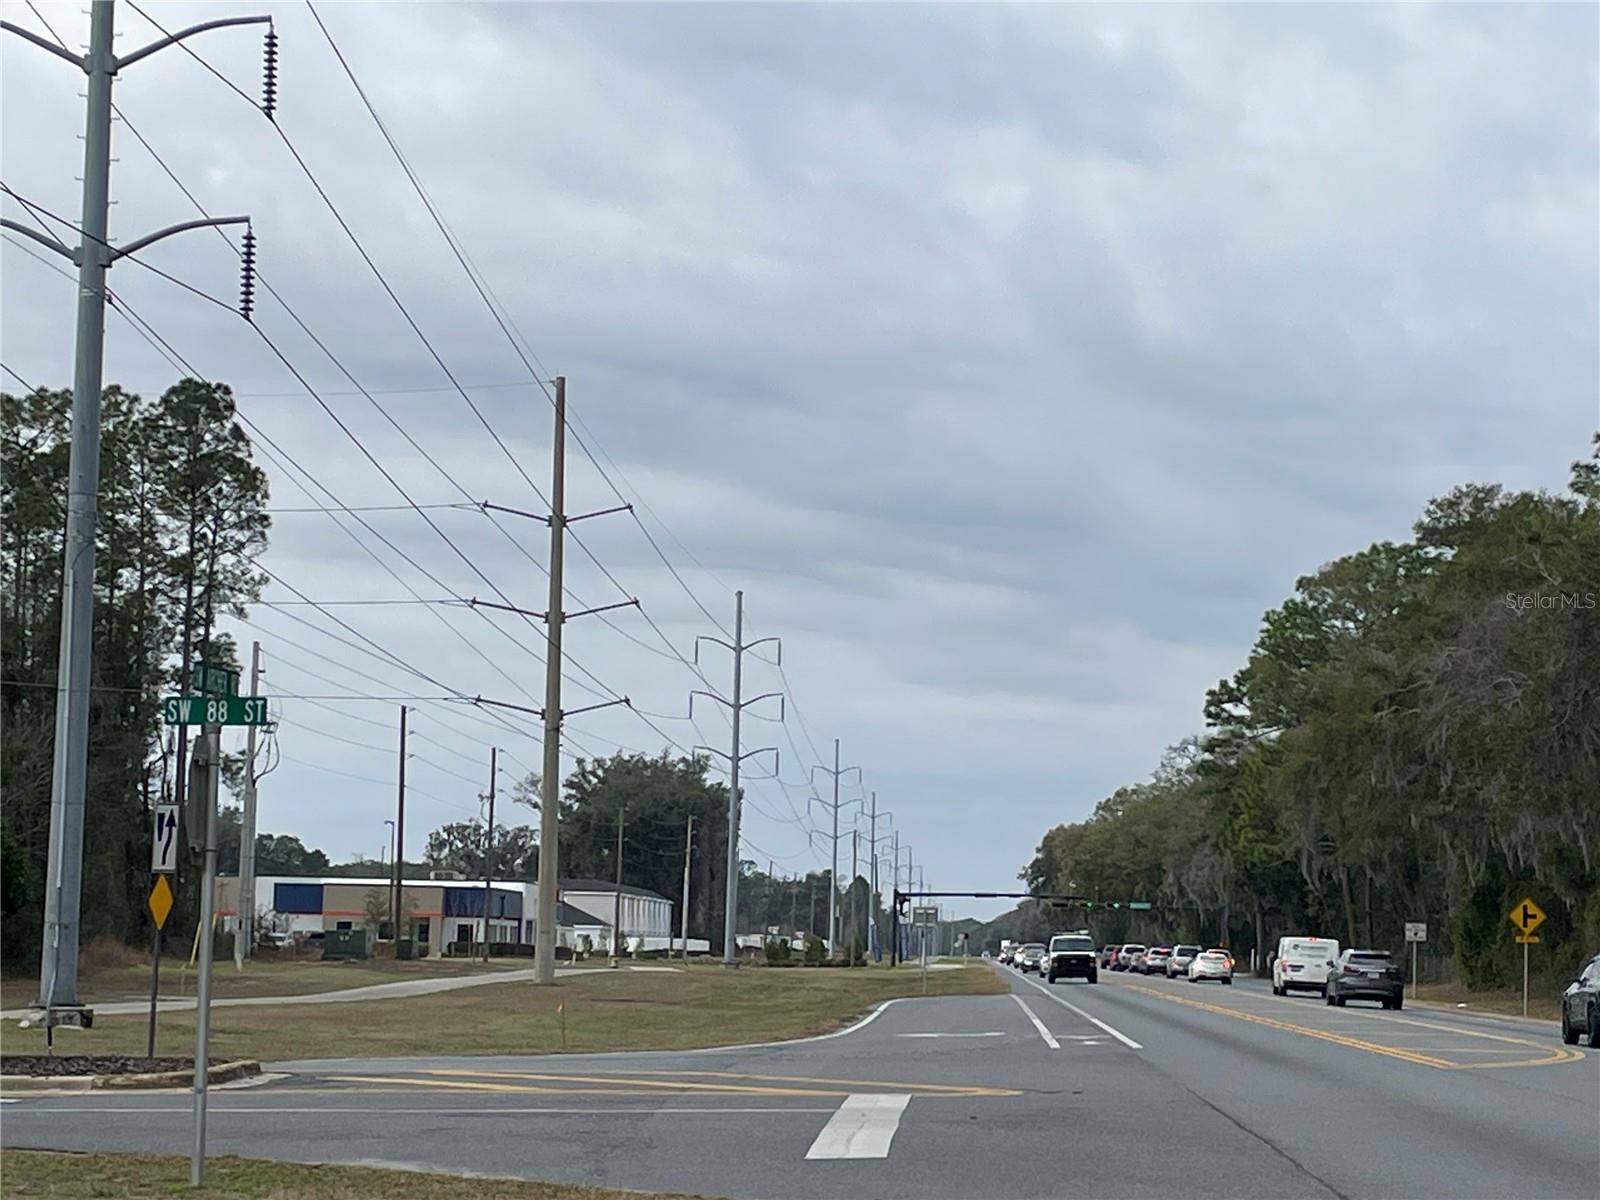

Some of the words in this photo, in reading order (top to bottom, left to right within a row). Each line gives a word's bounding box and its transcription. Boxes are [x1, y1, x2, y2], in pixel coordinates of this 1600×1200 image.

[167, 699, 192, 723] SW
[206, 700, 228, 723] 88
[243, 699, 265, 723] ST
